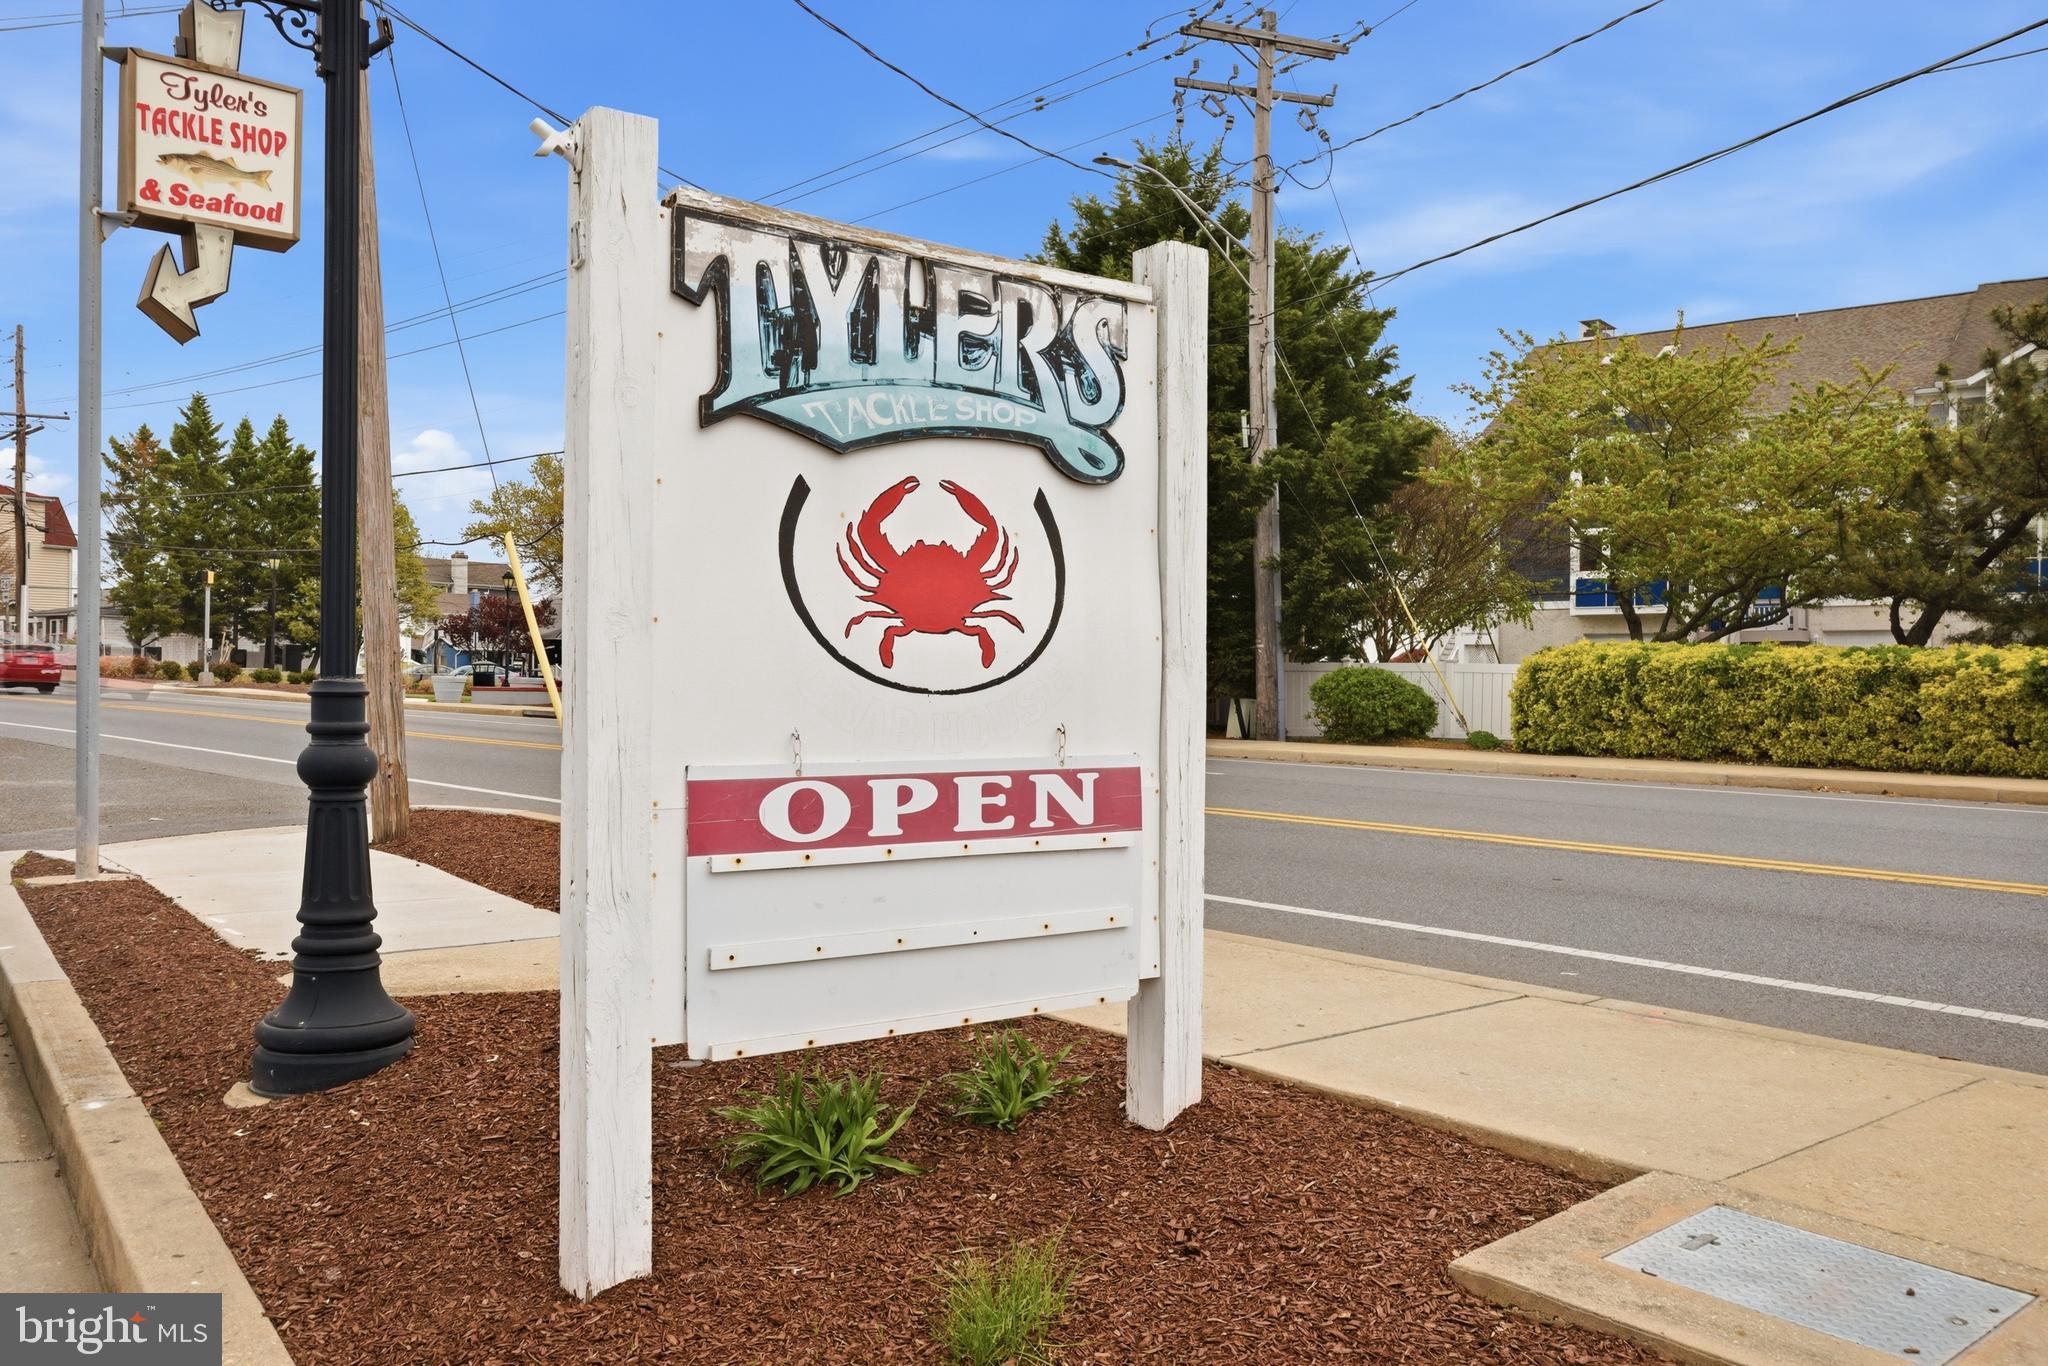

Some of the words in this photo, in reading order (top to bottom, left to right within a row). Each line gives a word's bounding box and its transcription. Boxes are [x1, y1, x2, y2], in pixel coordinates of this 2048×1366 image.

[160, 71, 268, 117] Tyler's
[136, 102, 224, 146] TACKLE
[231, 122, 288, 156] SHOP
[139, 178, 161, 203] &
[168, 182, 284, 224] Seafood
[802, 392, 949, 437] TACKLE
[954, 396, 1037, 427] SHOP
[758, 772, 1100, 843] OPEN
